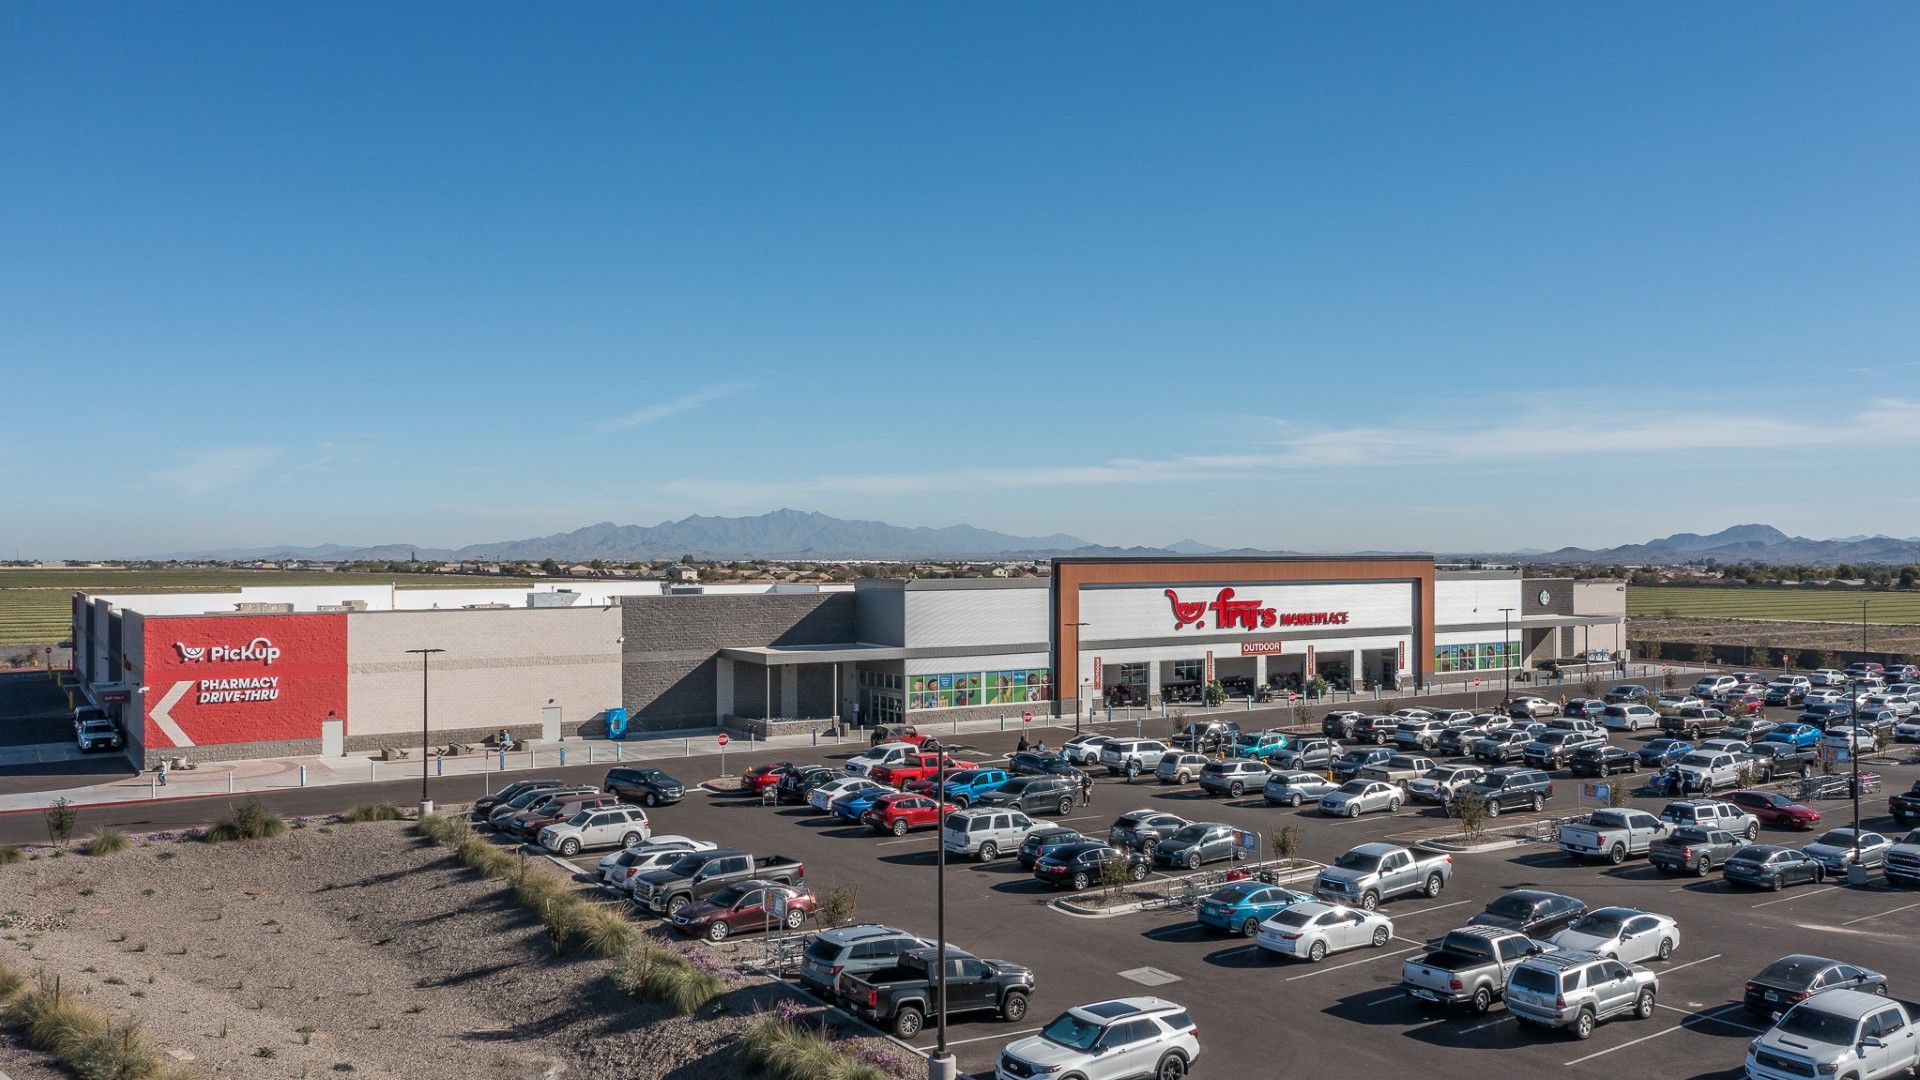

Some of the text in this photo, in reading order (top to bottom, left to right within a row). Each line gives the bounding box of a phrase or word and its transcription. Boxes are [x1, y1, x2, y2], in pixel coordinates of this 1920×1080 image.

[1209, 587, 1348, 630] fry's MARKETPLACE
[1243, 642, 1280, 651] OUTDOOR
[201, 677, 279, 690] PHARMACY
[200, 689, 279, 703] DRIVE-THRU
